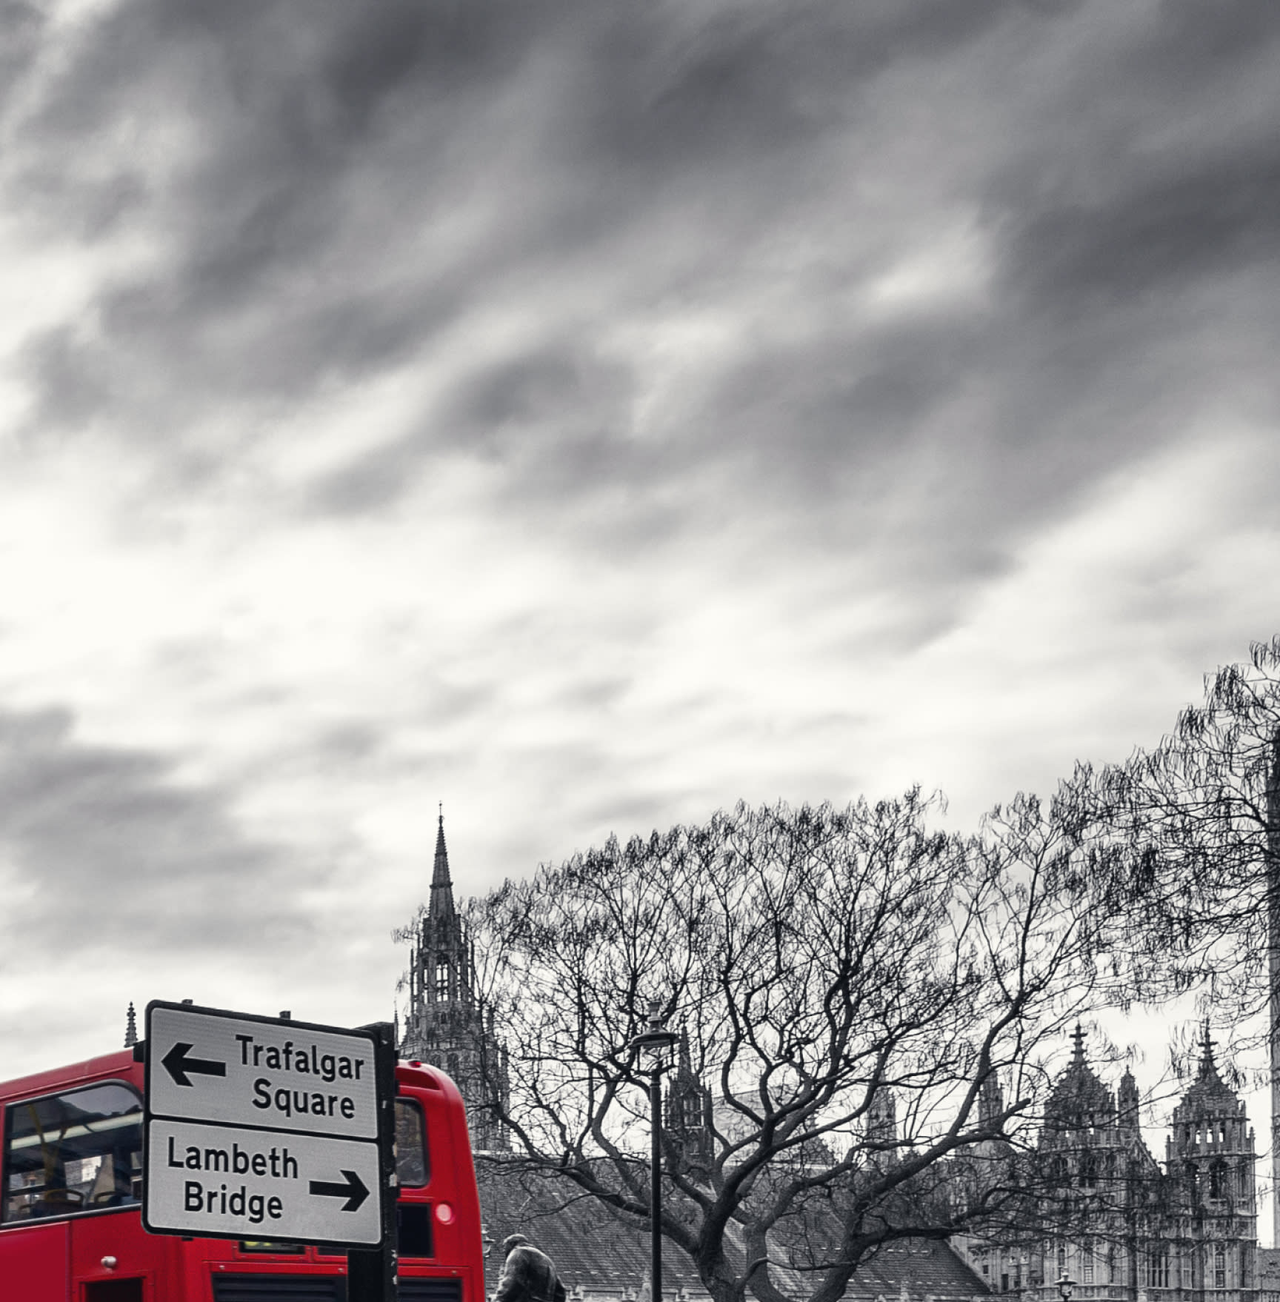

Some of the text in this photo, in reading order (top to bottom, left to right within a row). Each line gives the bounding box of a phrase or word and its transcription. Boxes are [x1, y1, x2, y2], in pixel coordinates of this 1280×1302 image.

[235, 1034, 365, 1081] Trafalgar
[252, 1077, 355, 1118] Square
[168, 1136, 299, 1180] Lambeth
[184, 1181, 283, 1223] Bridge
